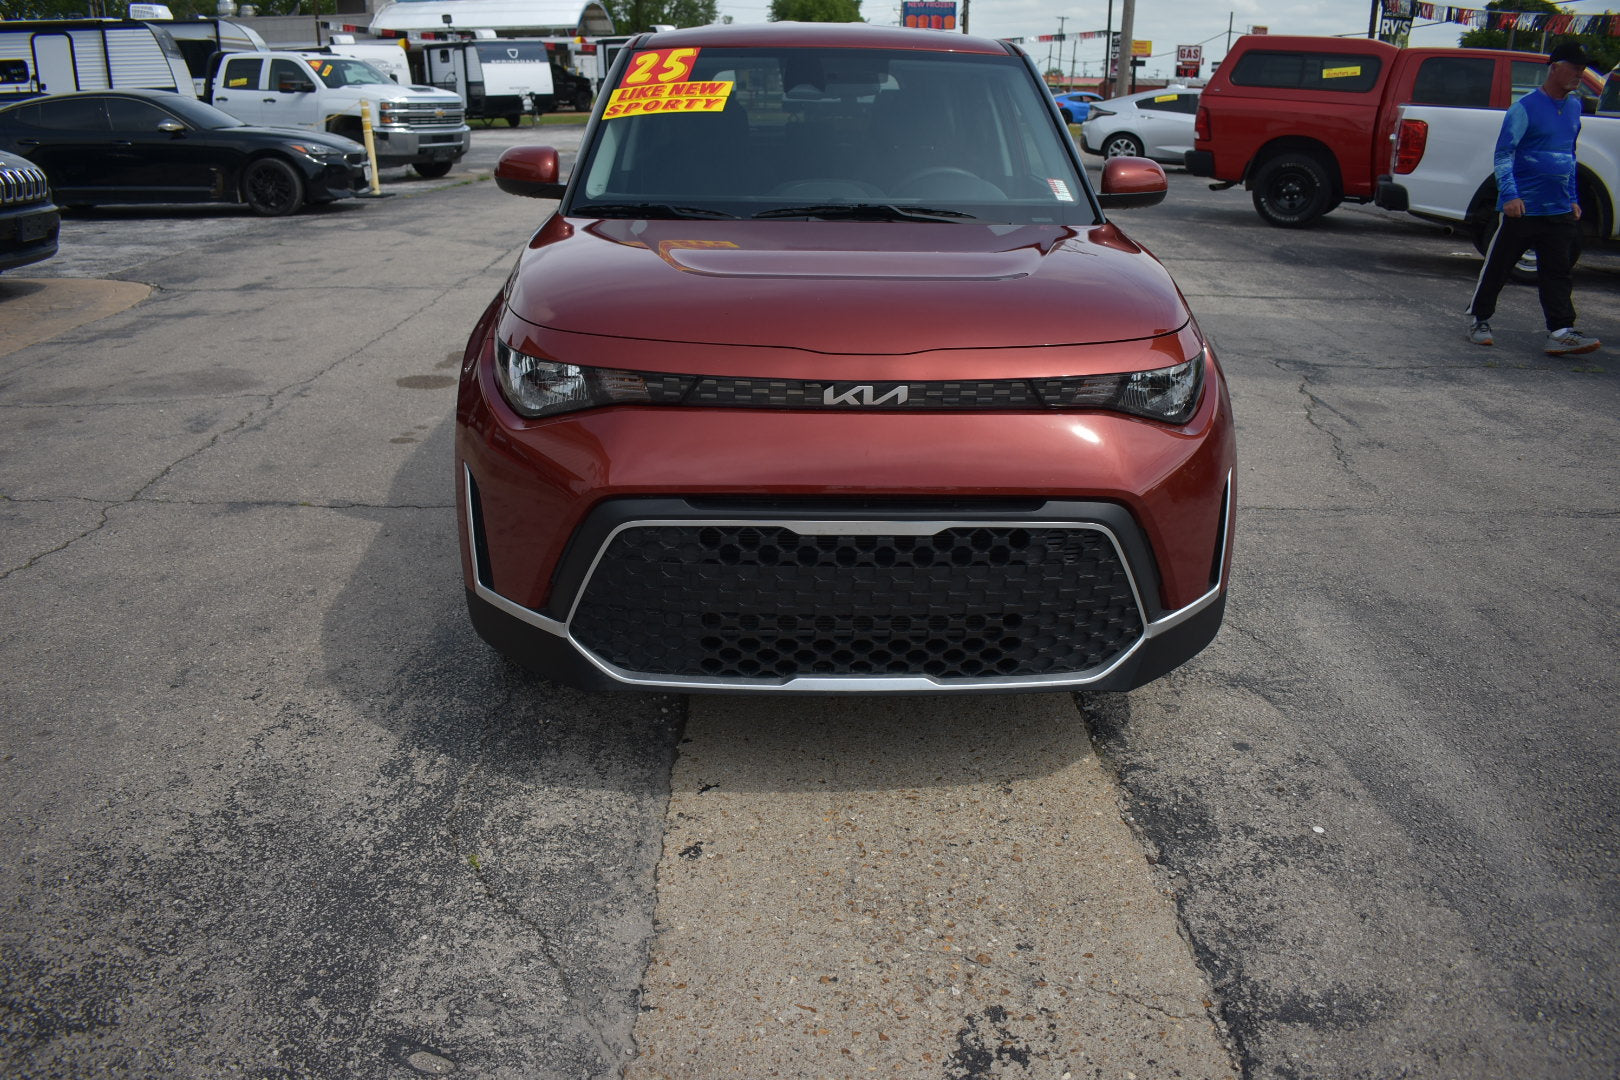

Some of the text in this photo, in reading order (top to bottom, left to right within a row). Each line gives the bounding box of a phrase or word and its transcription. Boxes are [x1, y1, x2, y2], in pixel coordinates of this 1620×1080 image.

[1381, 19, 1411, 35] RV'S
[1180, 48, 1199, 59] GAS
[626, 48, 697, 83] 25
[617, 82, 727, 102] LIKE NEW
[605, 98, 723, 116] SPORTY
[823, 385, 908, 405] KIA
